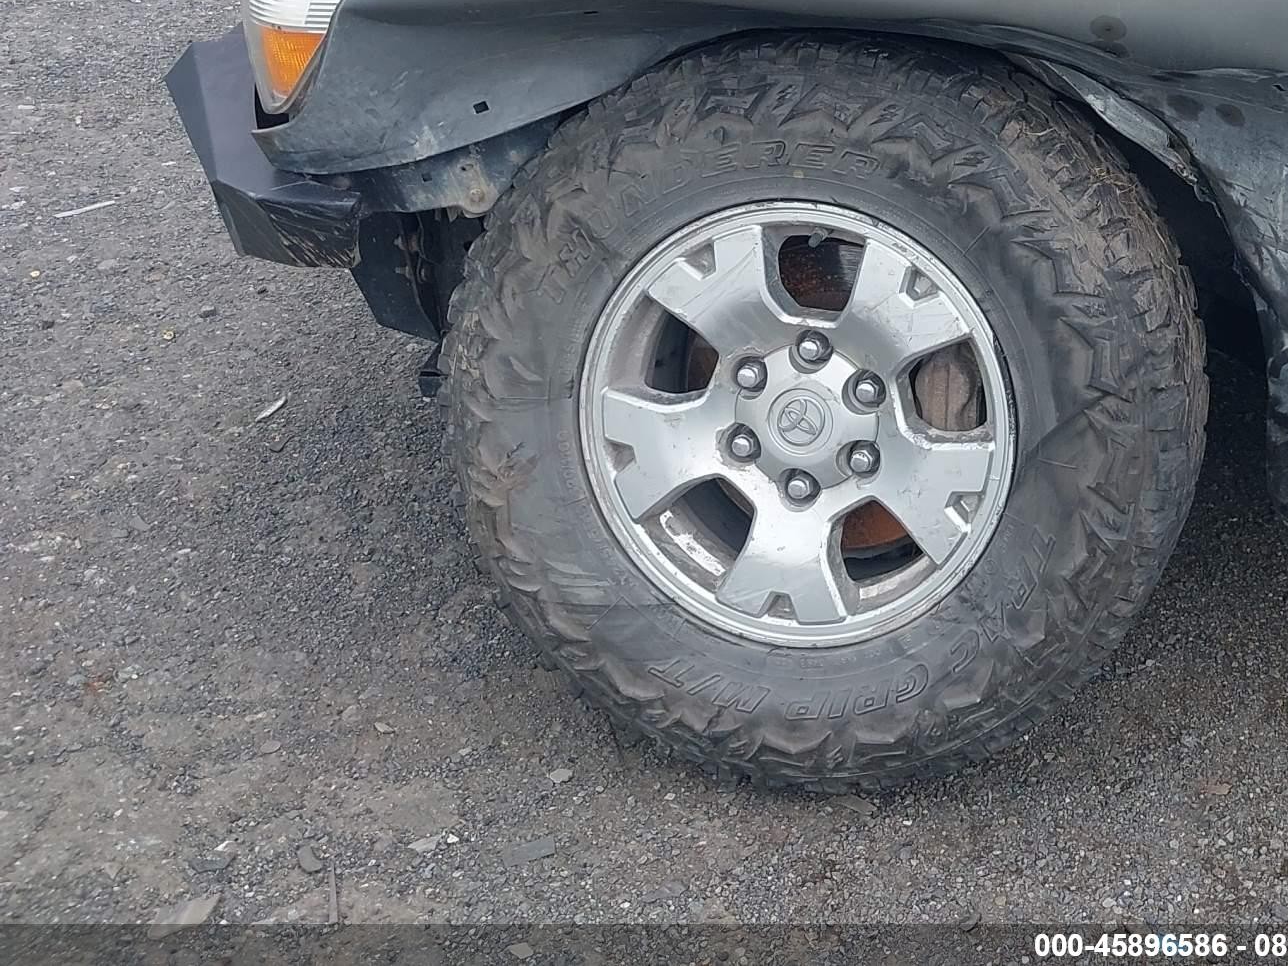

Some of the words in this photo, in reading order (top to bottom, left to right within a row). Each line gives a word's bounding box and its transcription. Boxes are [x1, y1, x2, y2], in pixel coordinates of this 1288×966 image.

[948, 526, 1056, 673] TRAC
[647, 658, 771, 714] M/T
[782, 662, 930, 721] GRIP
